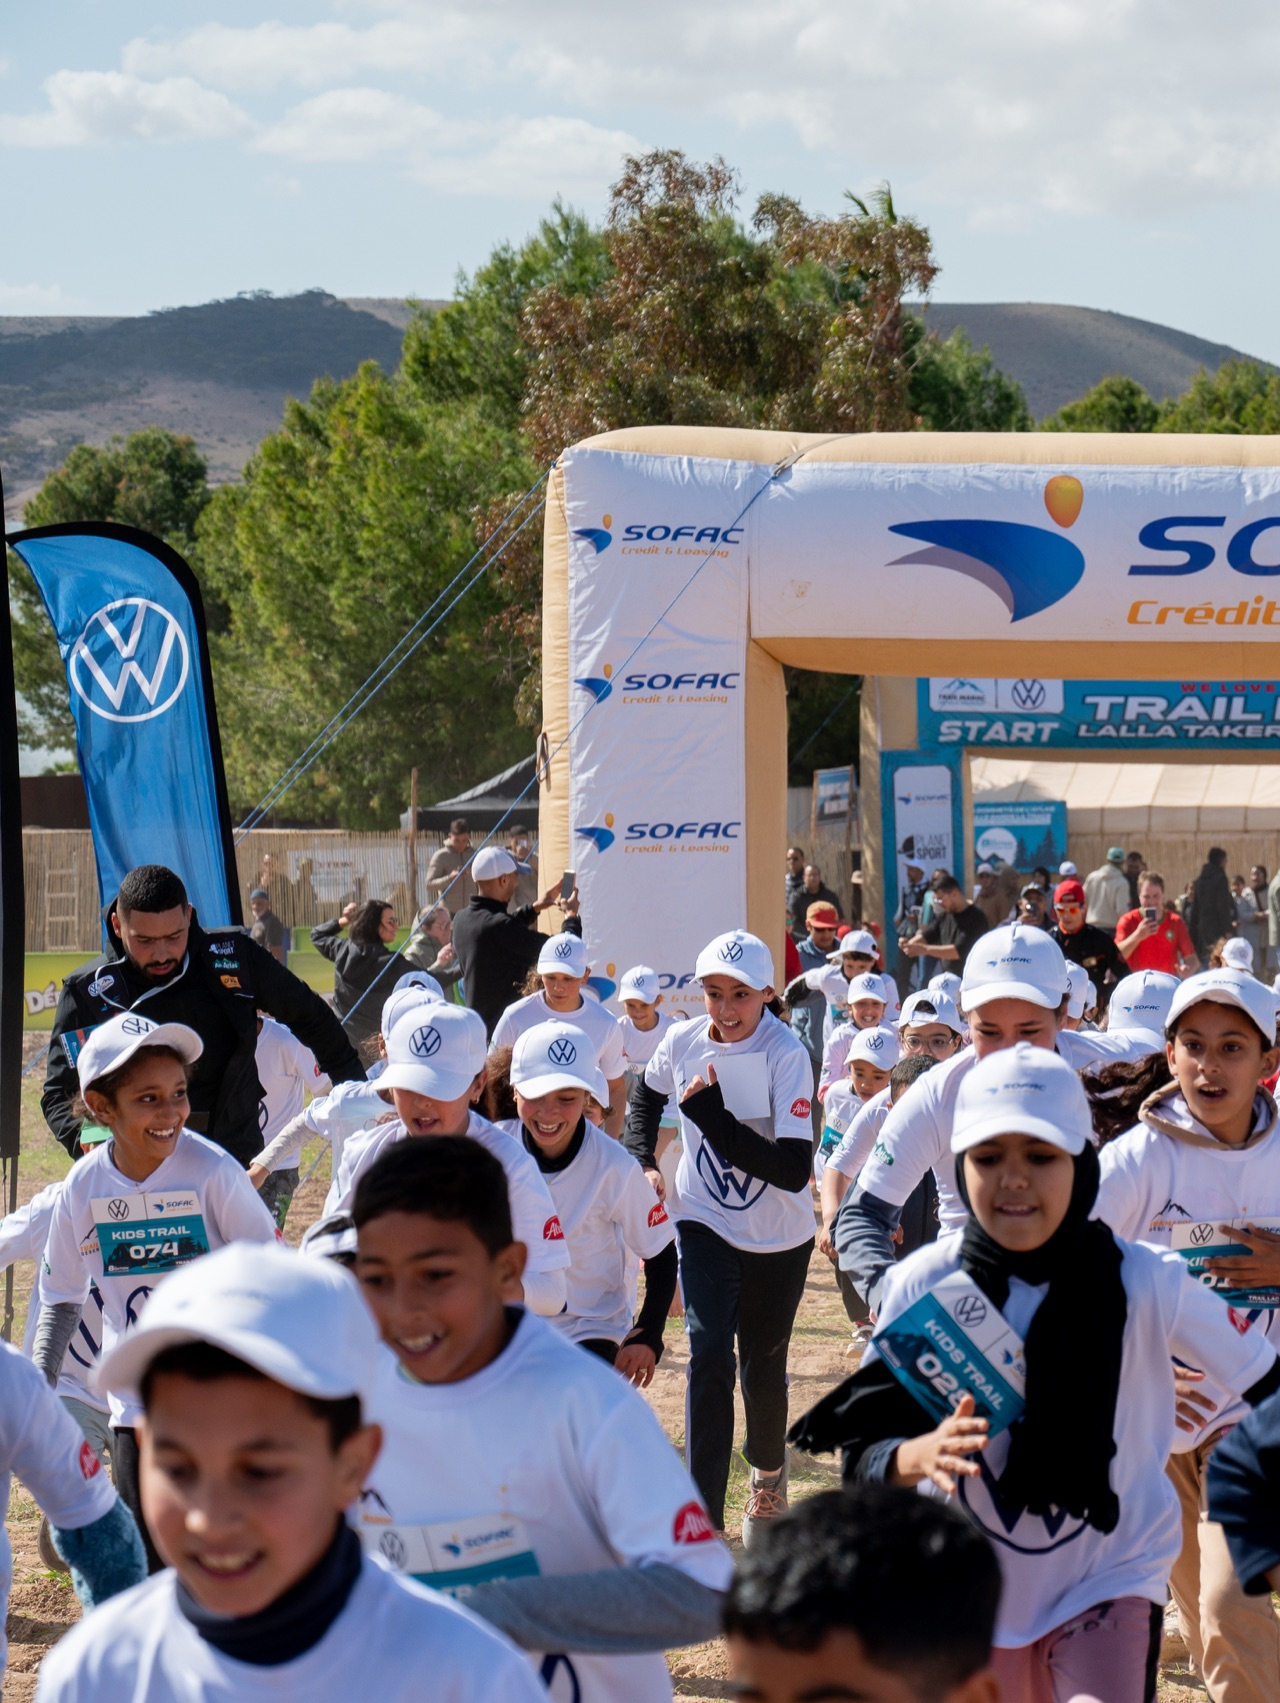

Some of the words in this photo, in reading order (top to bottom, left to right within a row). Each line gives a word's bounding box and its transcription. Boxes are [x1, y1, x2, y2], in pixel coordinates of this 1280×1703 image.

[622, 525, 745, 544] SOFAC
[622, 672, 741, 691] SOFAC
[1220, 683, 1276, 693] LOVE
[1084, 695, 1262, 722] TRAIL
[938, 720, 1060, 743] START
[1078, 724, 1177, 739] LALLA
[624, 822, 742, 841] SOFAC
[915, 846, 947, 860] SPORT
[166, 1200, 194, 1209] SOFAC
[112, 1229, 146, 1241] KIDS
[148, 1226, 191, 1238] TRAIL
[129, 1242, 179, 1260] 074
[923, 1319, 966, 1365] KIDS
[962, 1361, 1005, 1411] TRAIL
